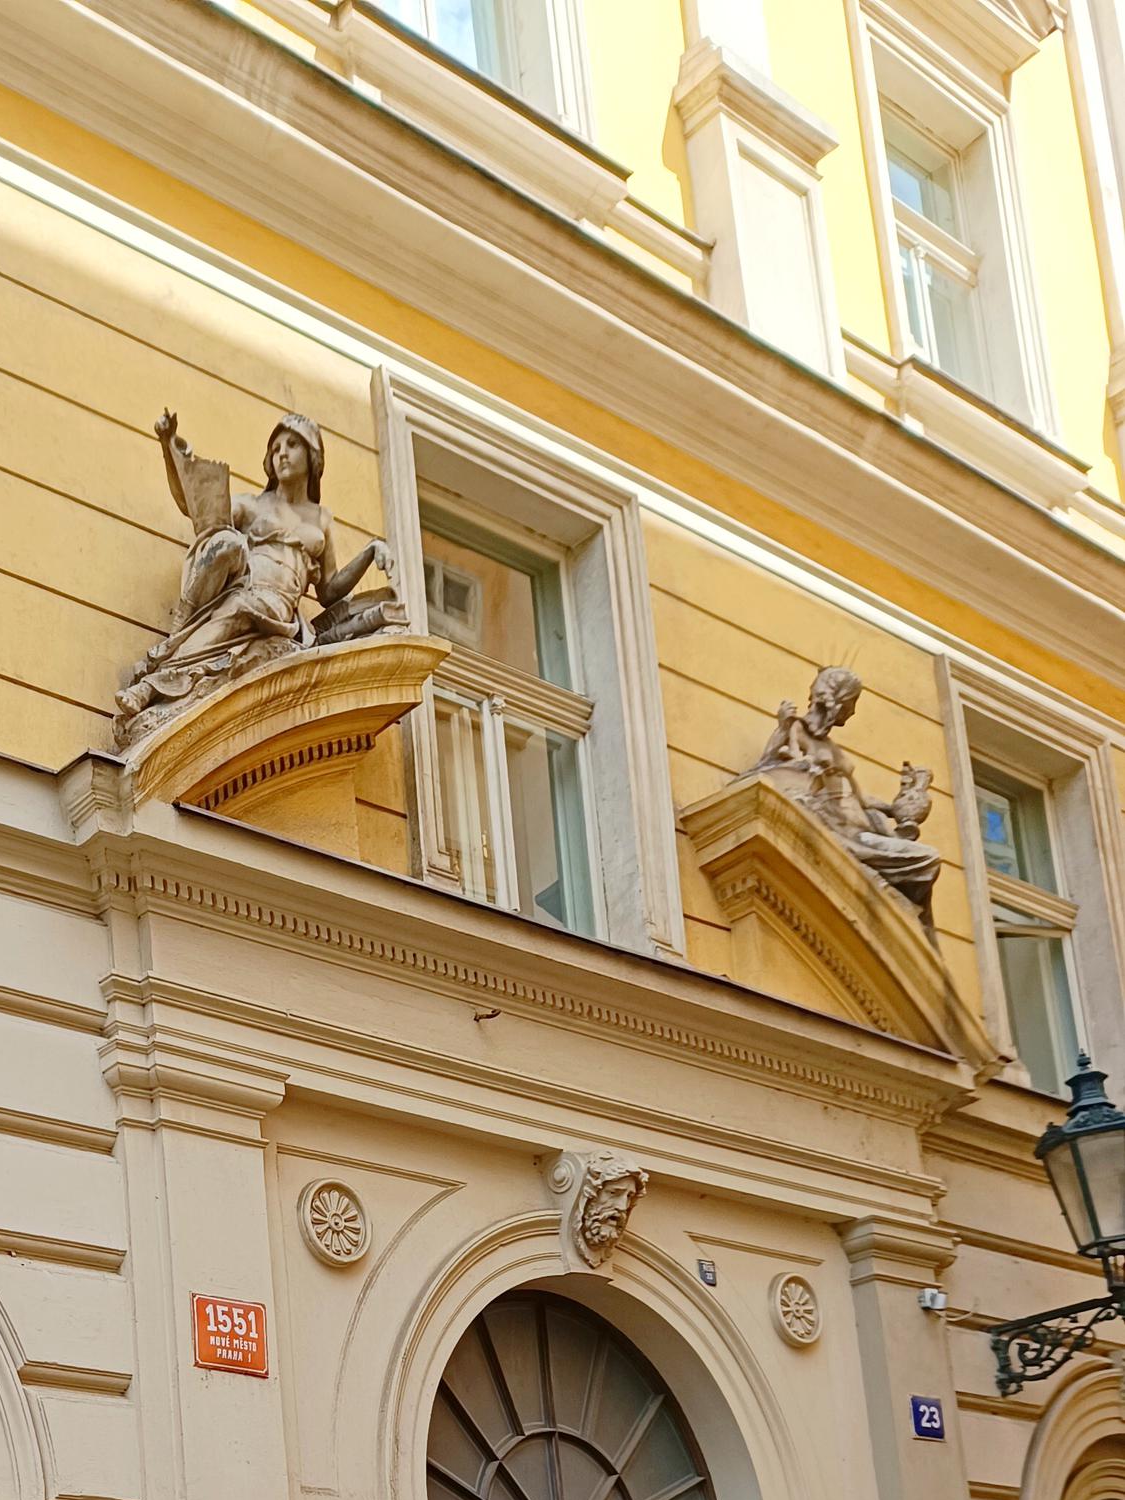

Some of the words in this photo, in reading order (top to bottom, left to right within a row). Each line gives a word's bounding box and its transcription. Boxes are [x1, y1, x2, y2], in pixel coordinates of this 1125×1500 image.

[205, 1303, 258, 1338] 1551
[210, 1335, 230, 1347] NOVÉ
[233, 1337, 257, 1352] MĚSTO
[217, 1348, 243, 1362] PRAHA
[919, 1405, 940, 1428] 23
